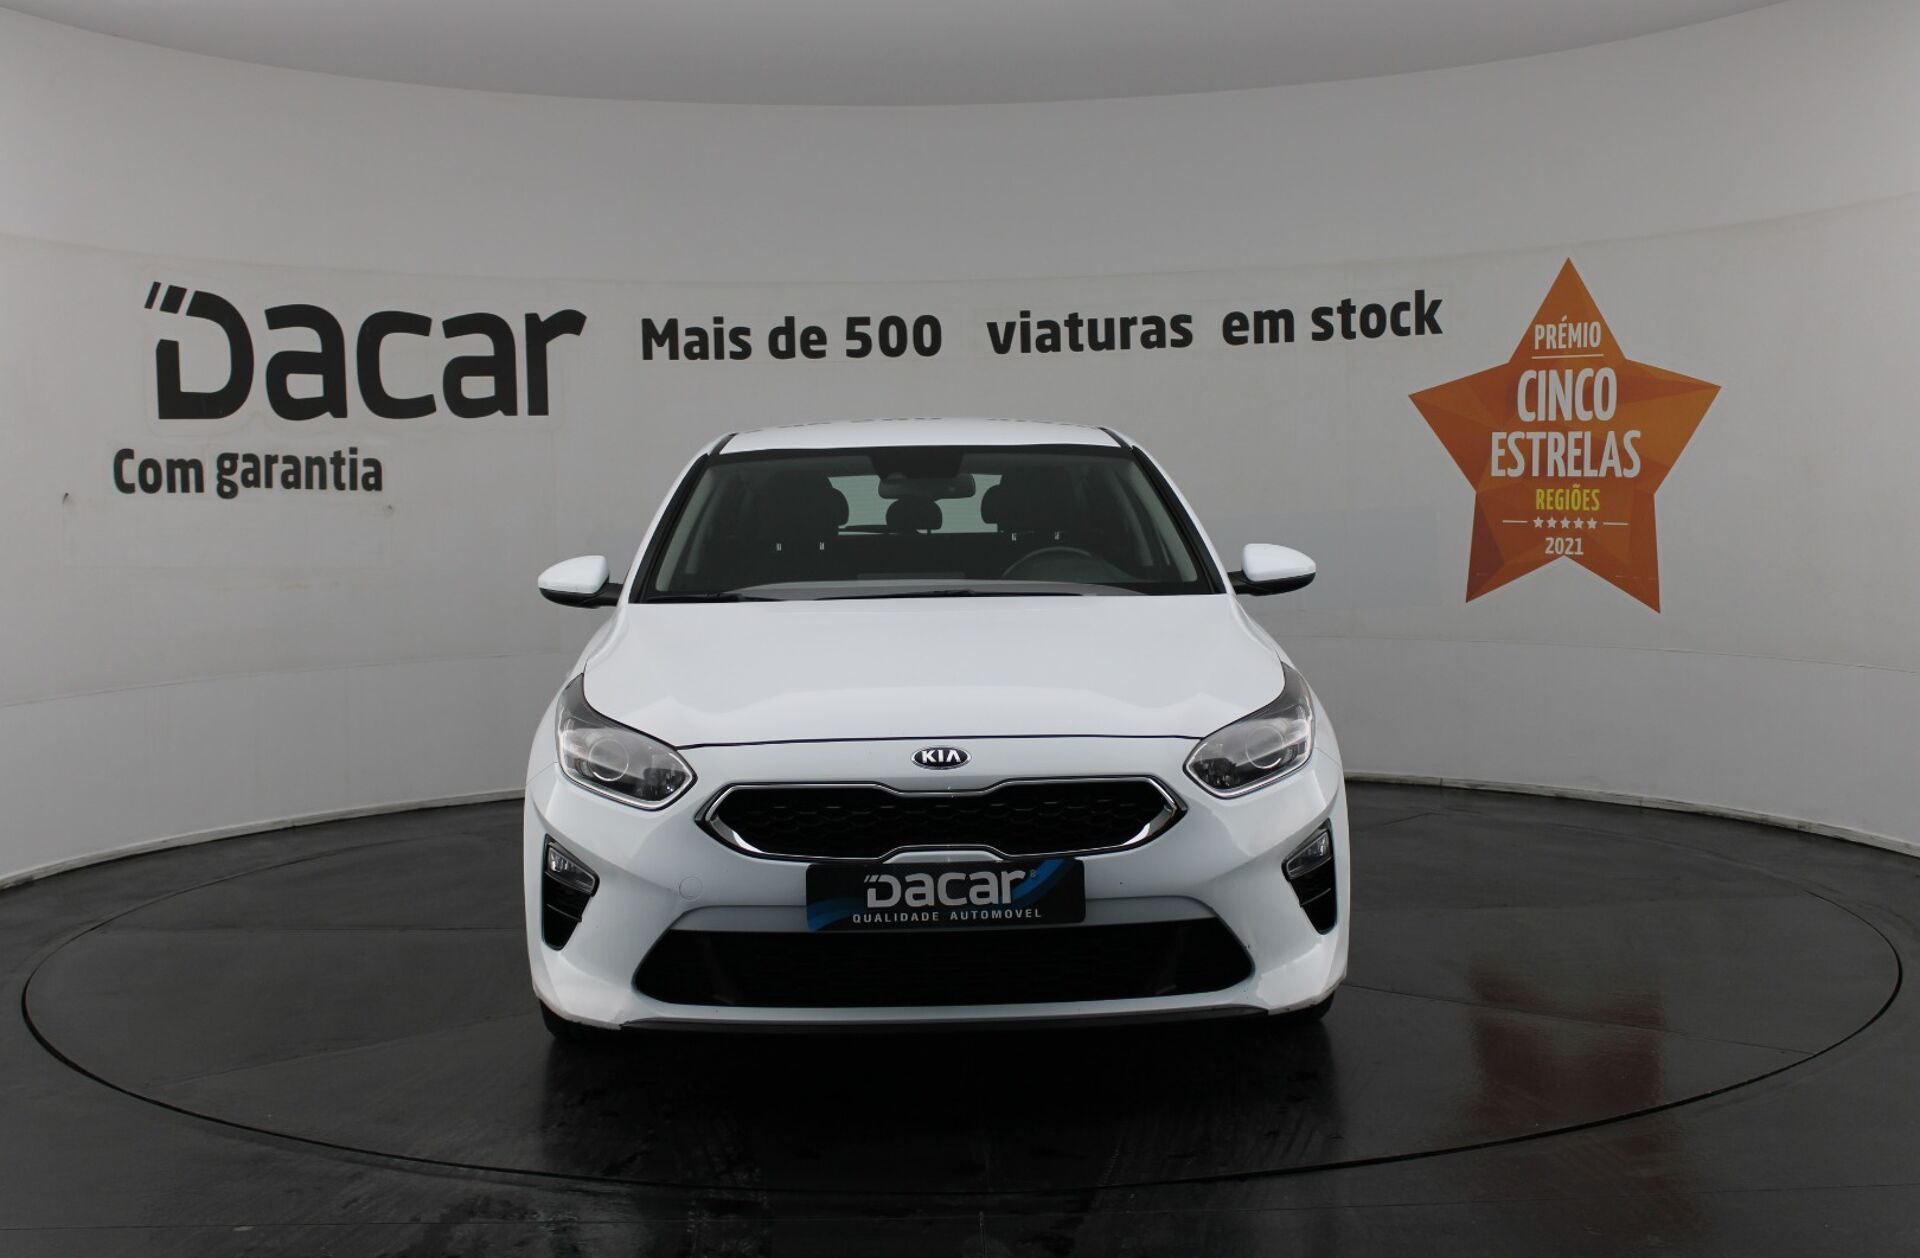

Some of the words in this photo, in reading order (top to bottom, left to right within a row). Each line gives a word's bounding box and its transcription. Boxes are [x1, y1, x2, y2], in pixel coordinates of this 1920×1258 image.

[641, 317, 753, 361] Mais
[768, 315, 829, 360] de
[845, 315, 942, 359] 500
[986, 309, 1193, 355] viaturas
[1222, 308, 1295, 345] em
[1311, 289, 1443, 343] stock
[1534, 315, 1601, 350] PRÉMIO
[144, 281, 588, 422] Dacar
[1517, 367, 1618, 423] CINCO
[113, 448, 205, 494] Com
[216, 446, 383, 500] garantia
[1490, 429, 1642, 479] ESTRELAS
[1535, 484, 1601, 512] REGIÕES
[1545, 537, 1584, 556] 2021
[921, 749, 962, 763] KIA
[863, 870, 1026, 908] Dacar
[852, 911, 940, 924] QUALIDADE
[950, 908, 1042, 921] AUTOMOVEL
